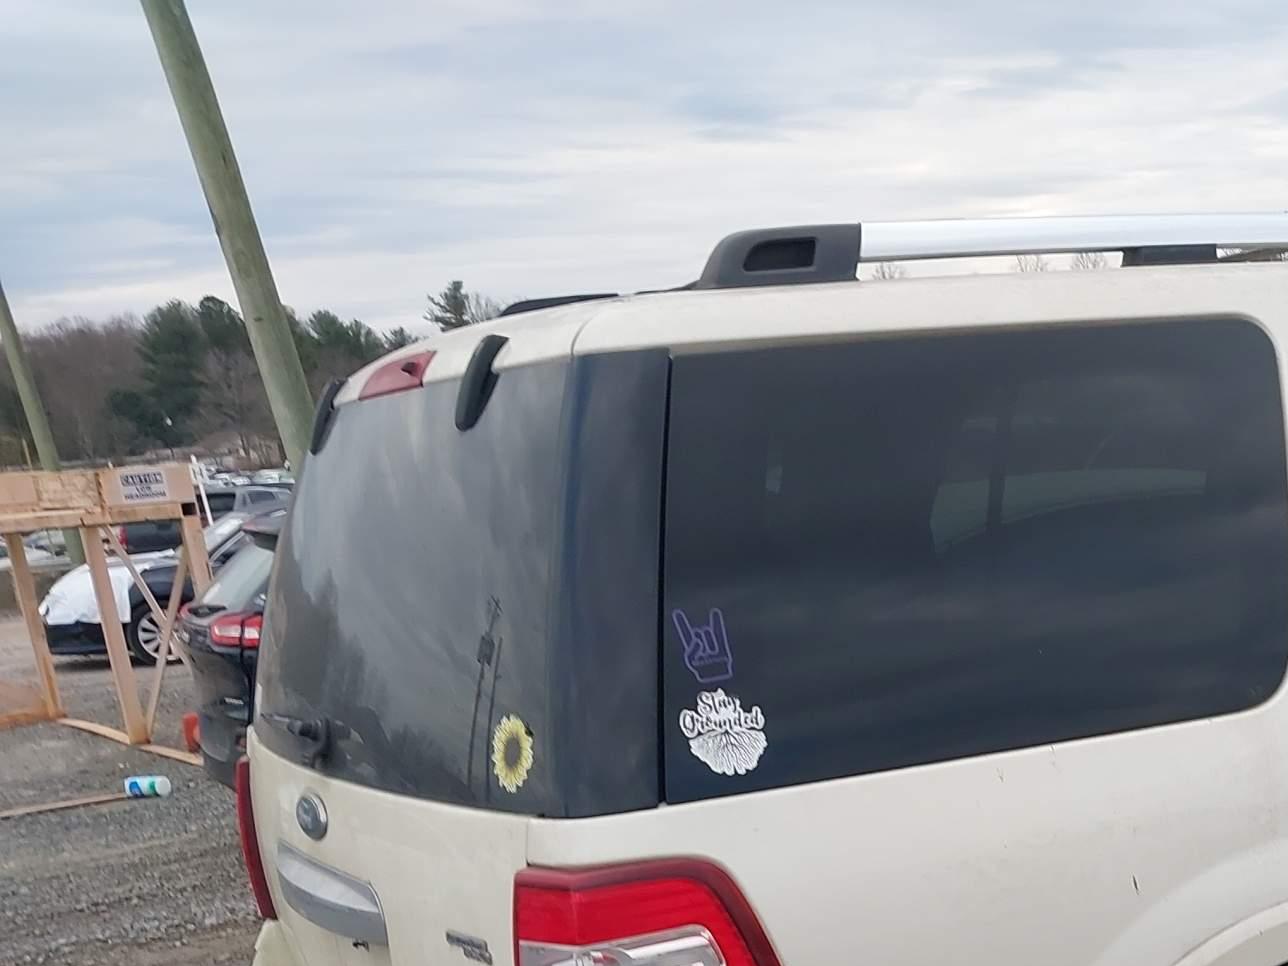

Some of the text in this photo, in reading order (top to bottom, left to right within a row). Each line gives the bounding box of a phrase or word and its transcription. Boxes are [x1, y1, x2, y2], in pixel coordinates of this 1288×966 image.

[120, 471, 164, 487] CAUTION
[698, 690, 740, 715] Stay
[681, 706, 763, 734] Grounded
